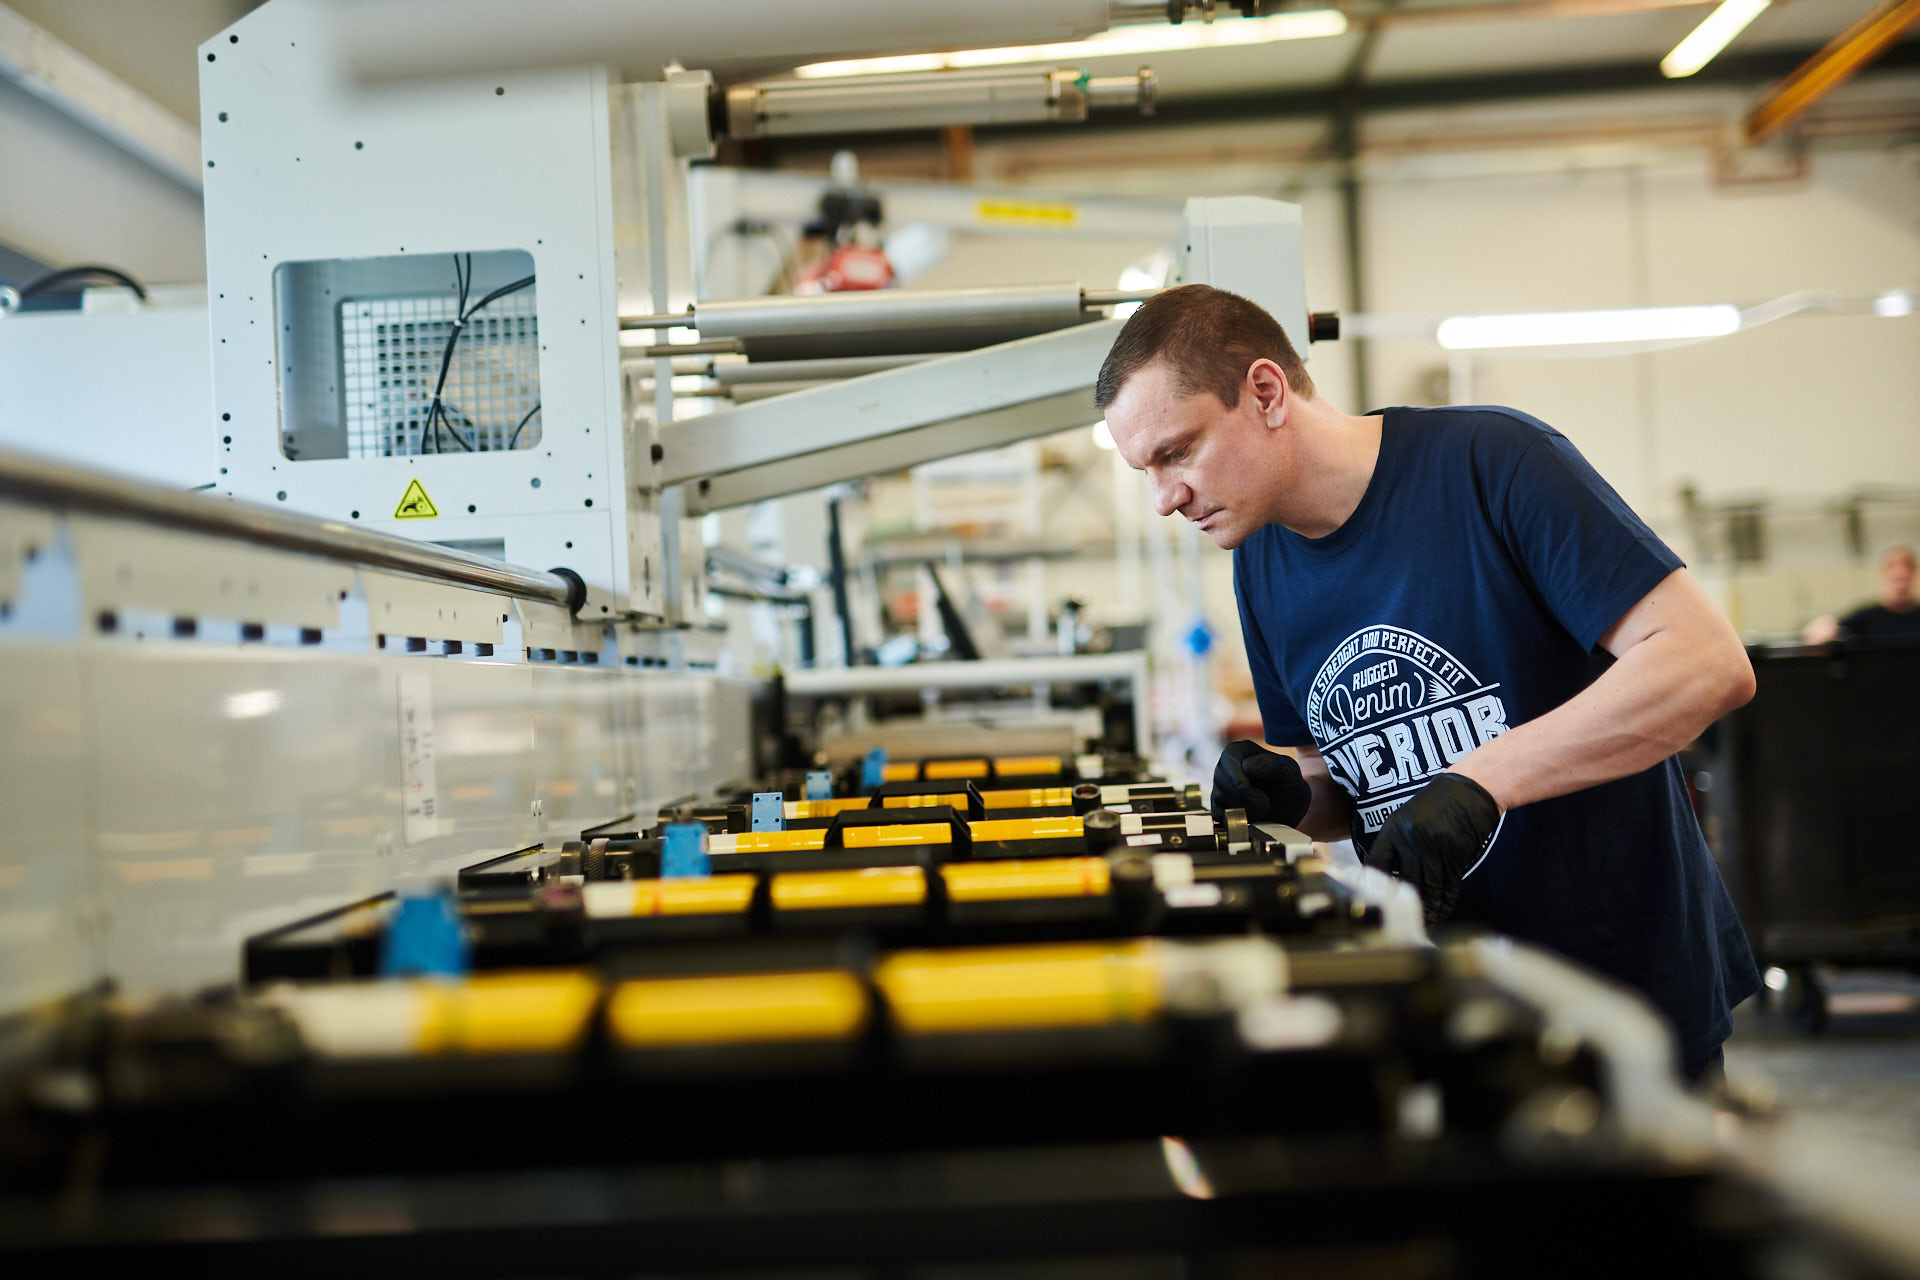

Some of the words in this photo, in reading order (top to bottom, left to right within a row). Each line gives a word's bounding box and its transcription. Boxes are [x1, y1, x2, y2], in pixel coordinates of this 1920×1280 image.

[1310, 691, 1323, 738] EXTRA
[1317, 639, 1360, 693] STRENGHT
[1362, 631, 1380, 650] AND
[1382, 631, 1441, 667] PERFECT
[1439, 660, 1466, 686] FIT
[1327, 672, 1425, 734] Denim
[1352, 659, 1398, 691] RUGGED
